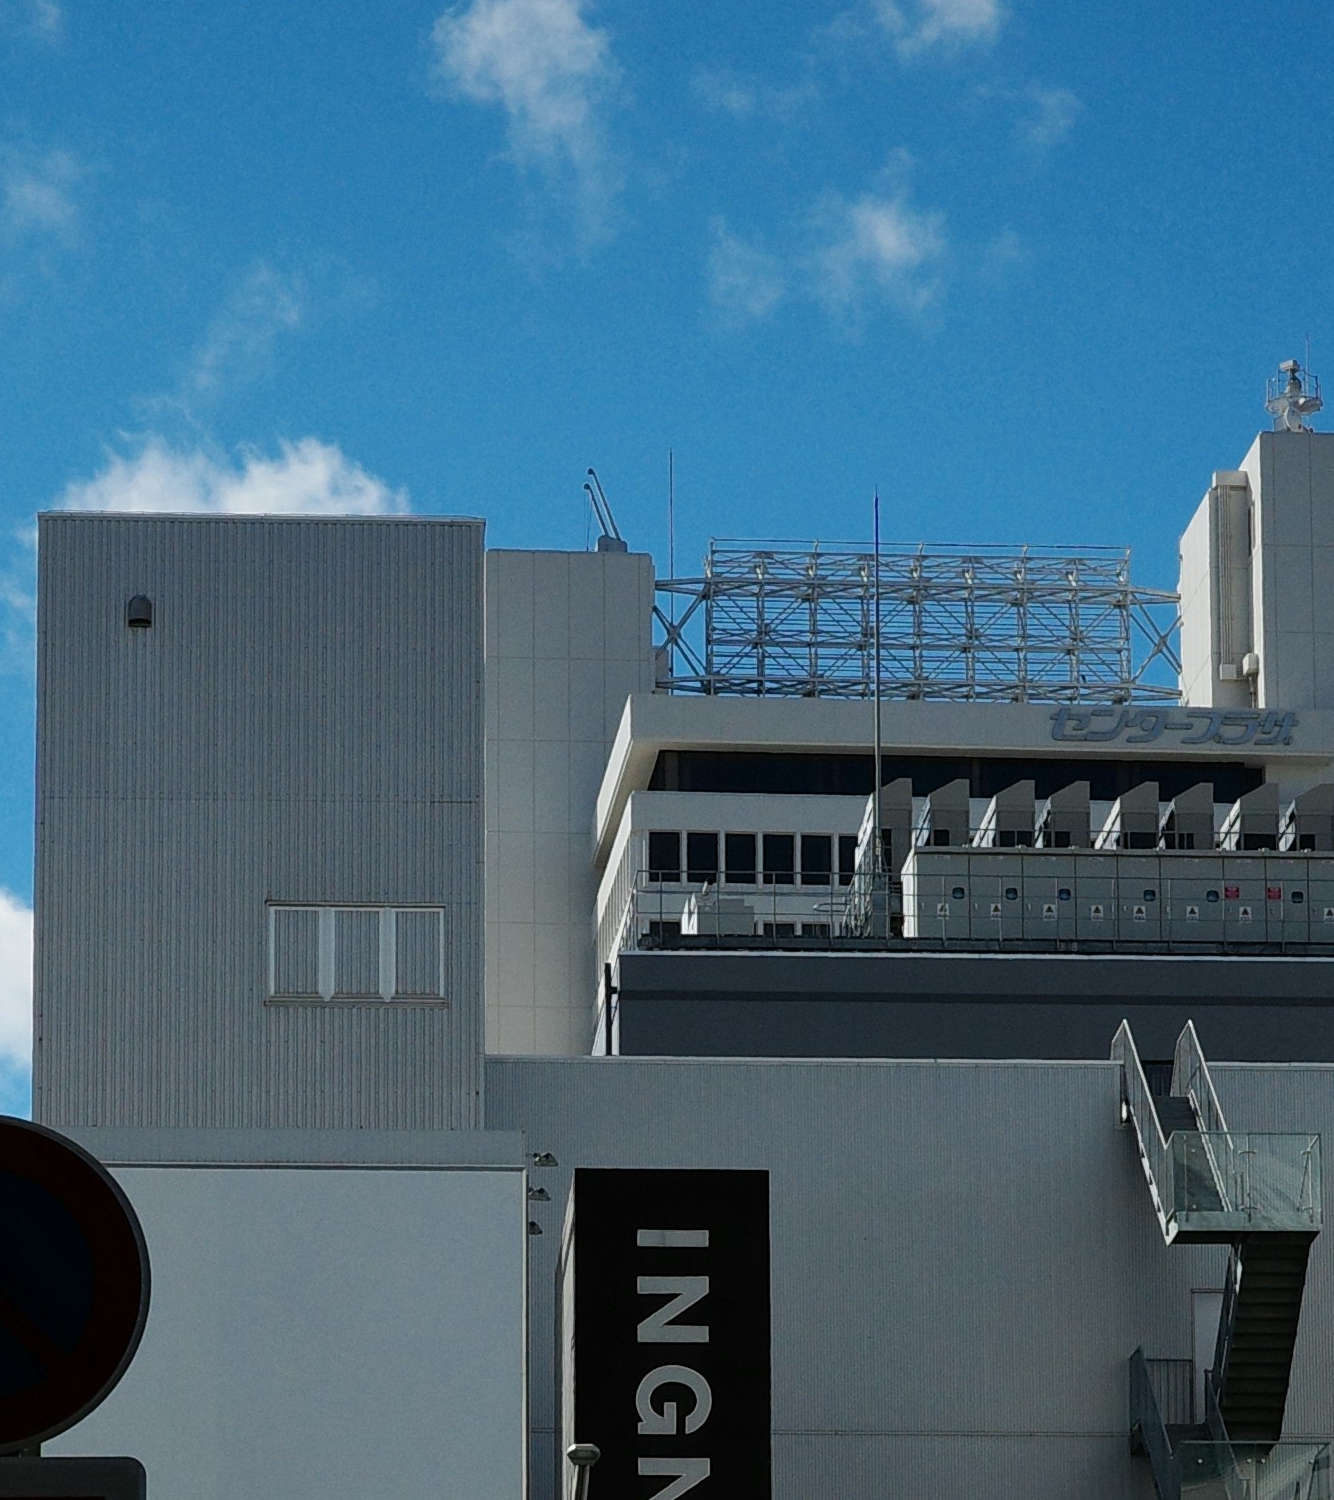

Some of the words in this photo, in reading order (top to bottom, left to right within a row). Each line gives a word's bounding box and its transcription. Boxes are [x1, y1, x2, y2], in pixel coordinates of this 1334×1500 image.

[1050, 707, 1299, 746] センタープラザ
